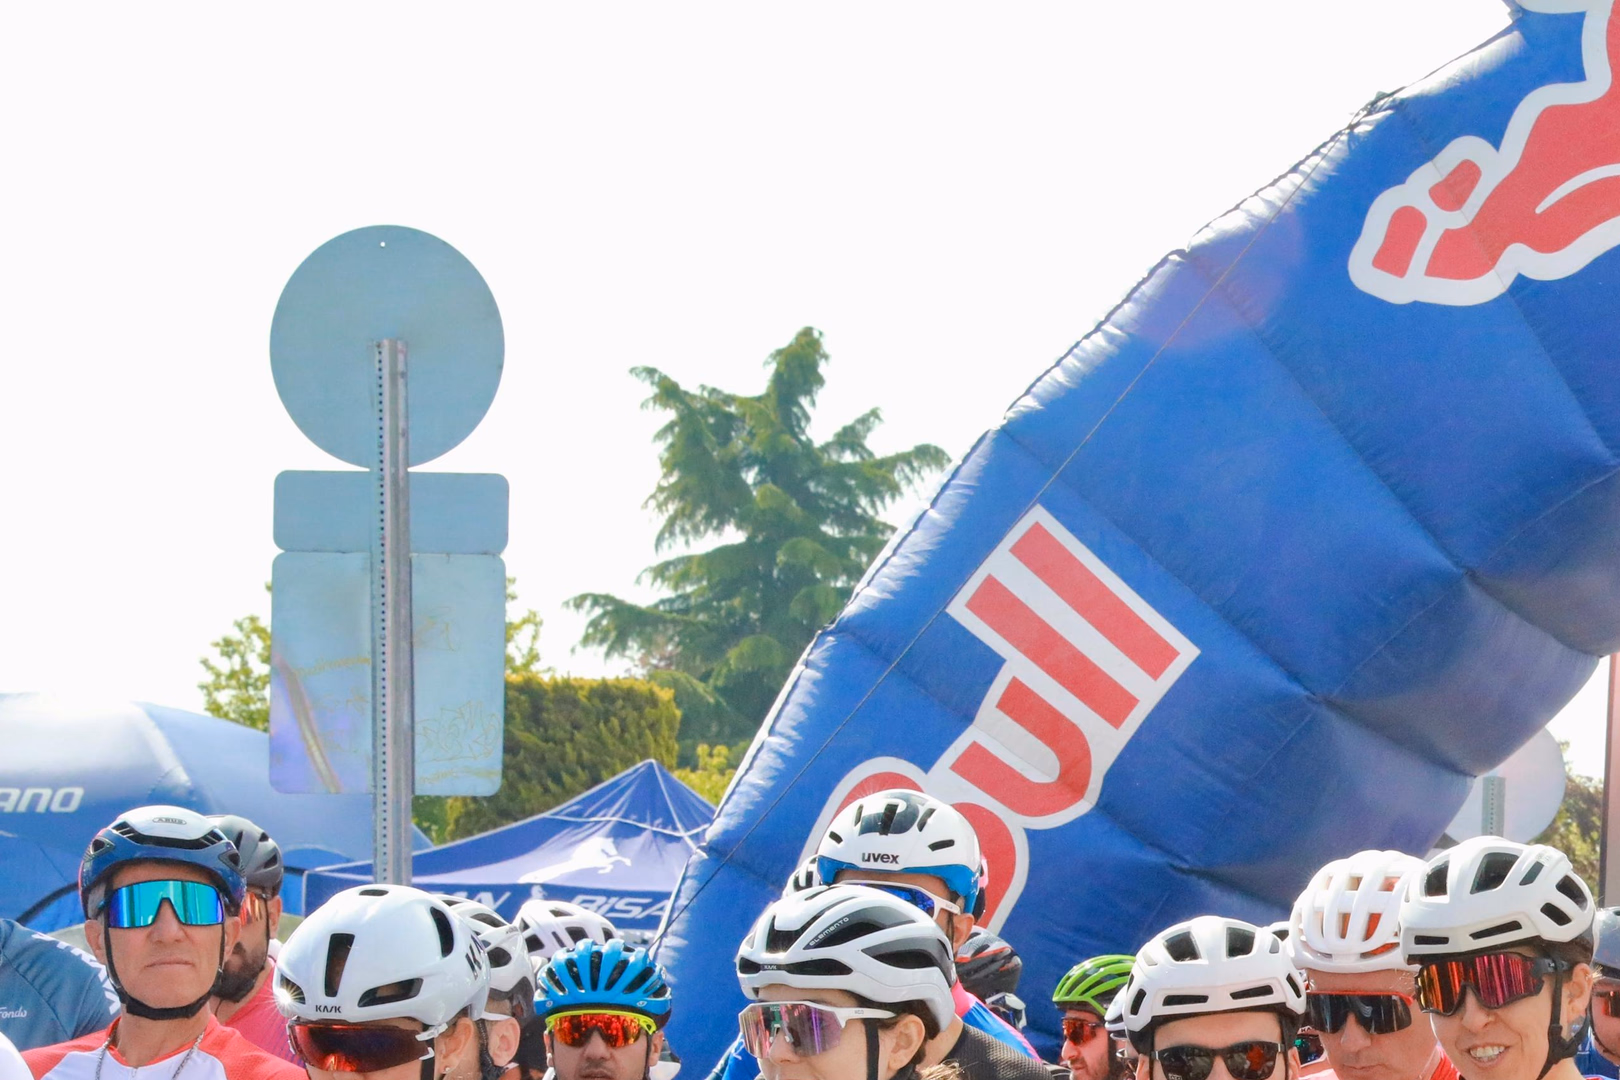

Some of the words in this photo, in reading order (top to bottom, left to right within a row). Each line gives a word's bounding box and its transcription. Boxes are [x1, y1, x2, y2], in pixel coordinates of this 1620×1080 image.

[862, 852, 899, 864] uvex
[572, 894, 669, 919] BISA
[315, 1004, 342, 1013] KASK
